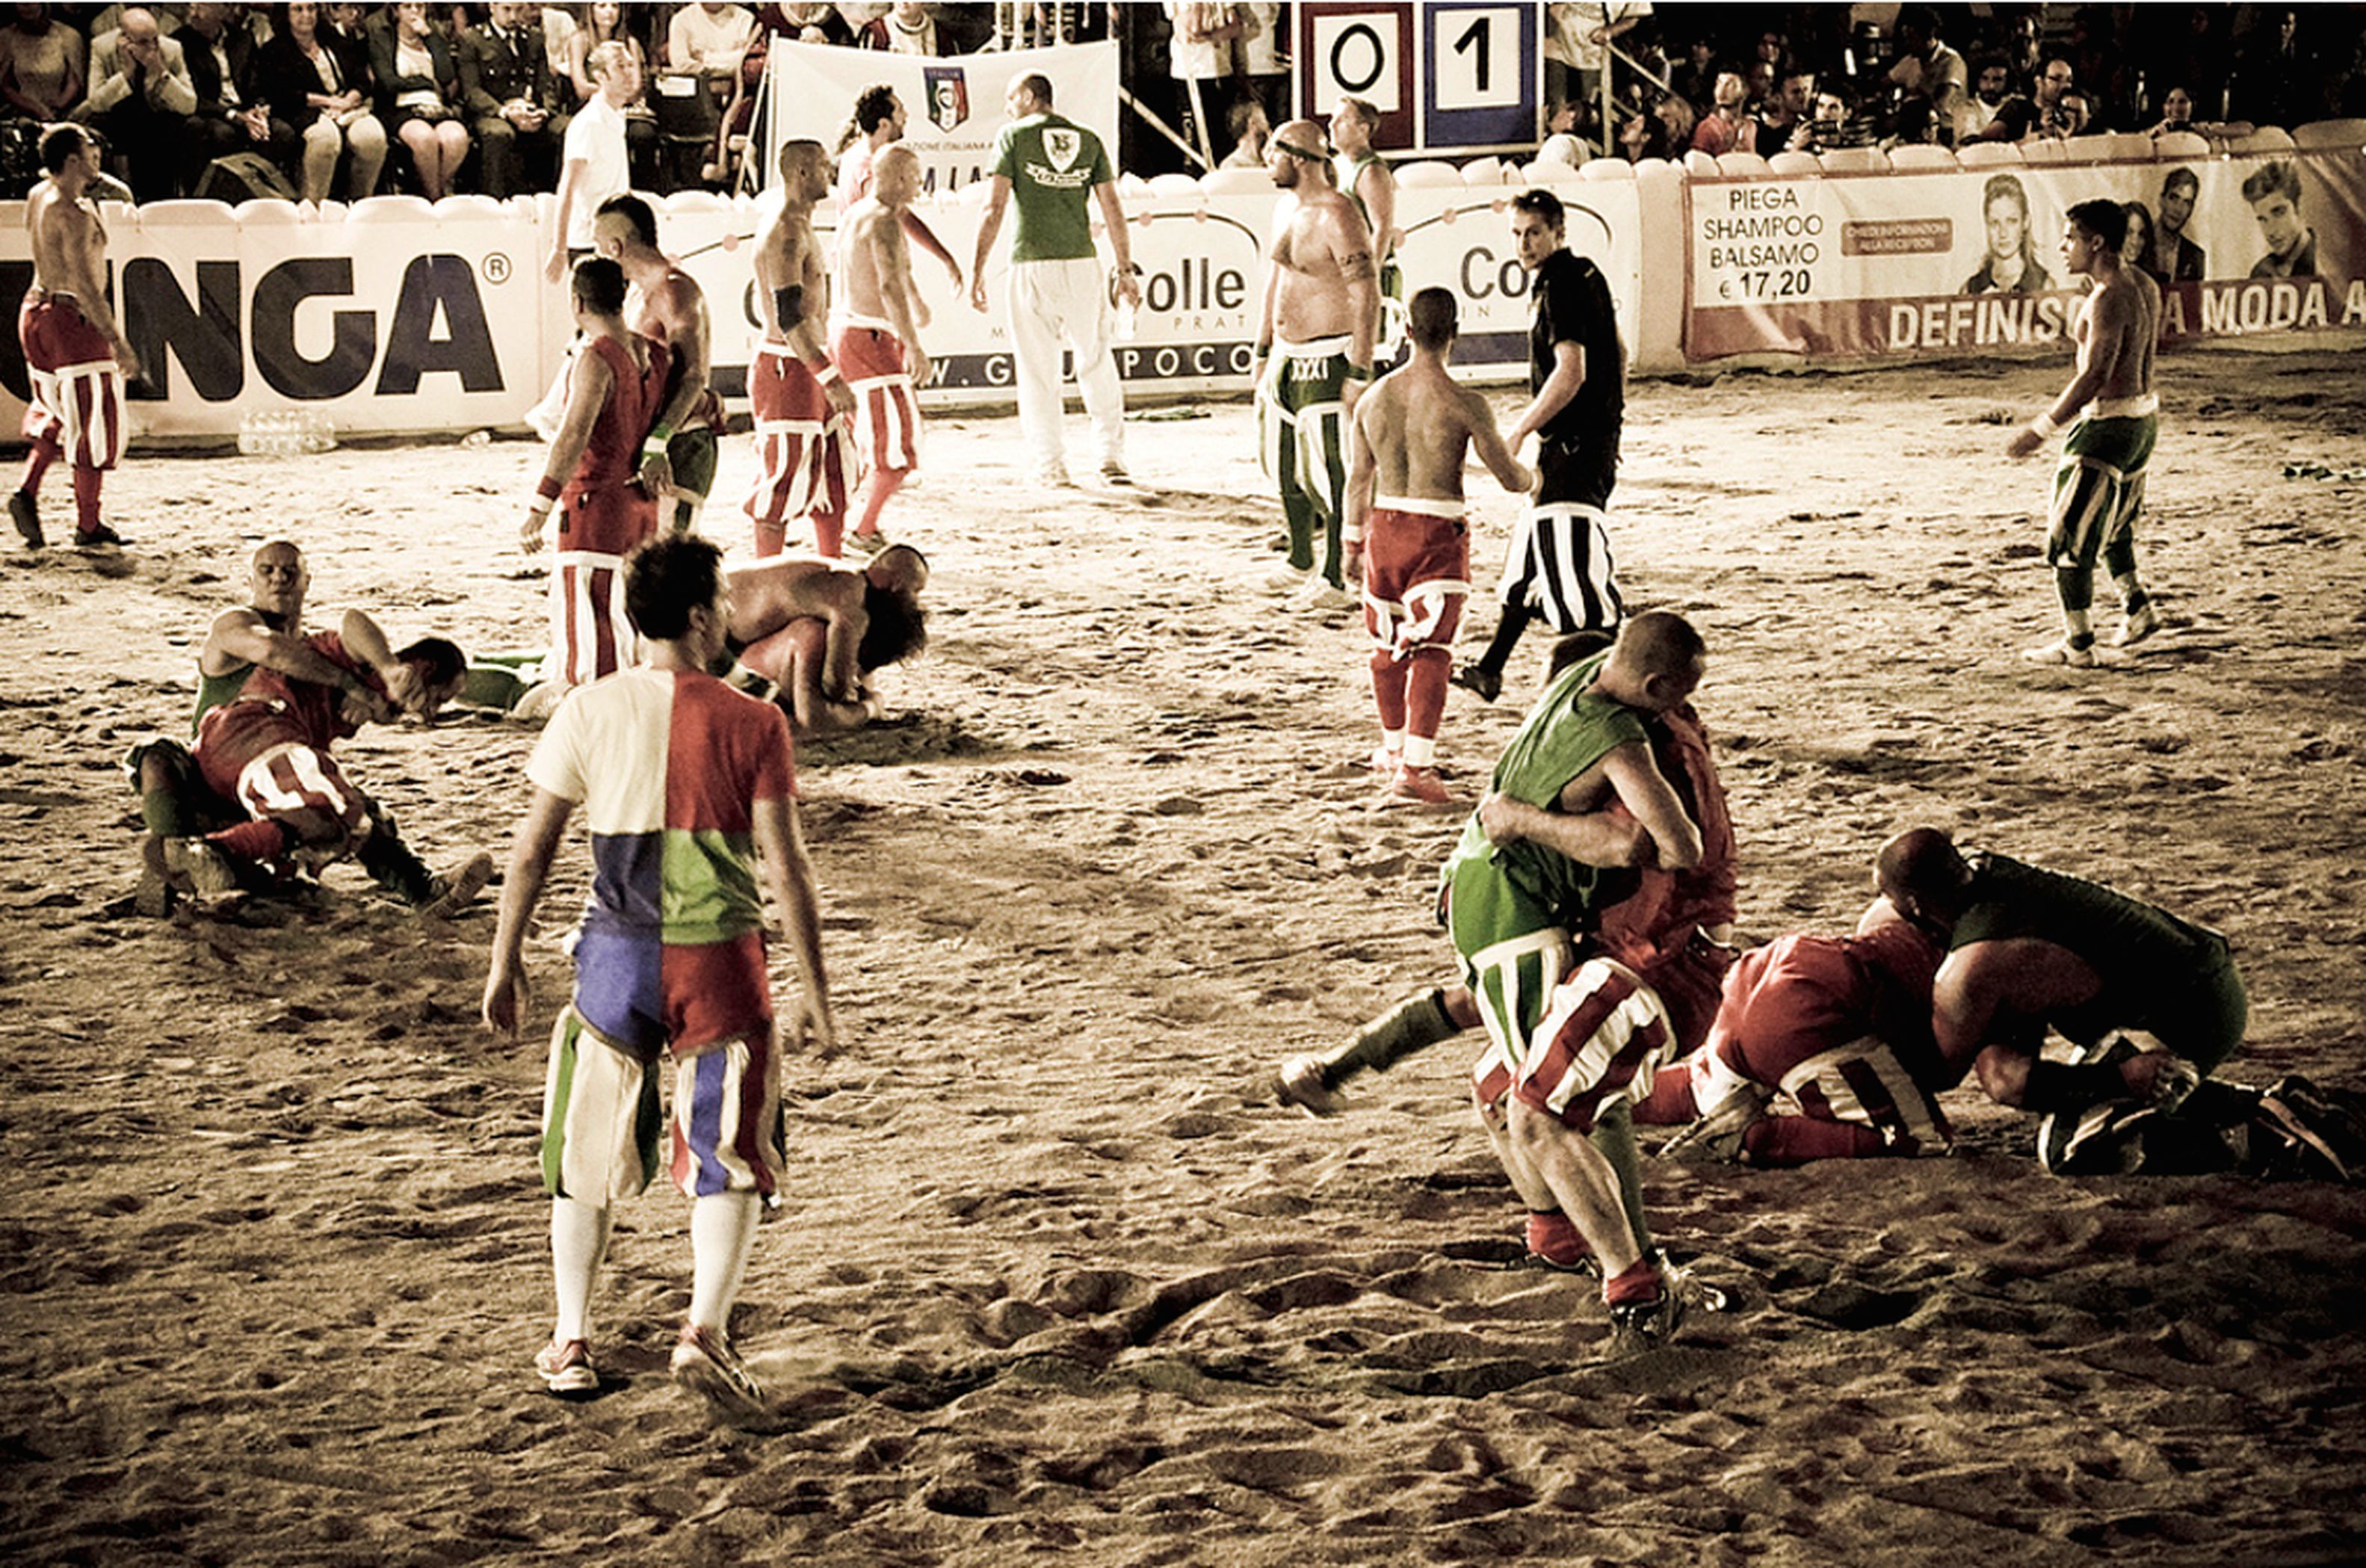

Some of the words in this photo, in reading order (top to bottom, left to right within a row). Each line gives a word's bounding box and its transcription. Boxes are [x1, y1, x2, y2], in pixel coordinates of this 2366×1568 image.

[1329, 22, 1385, 93] 0
[1454, 17, 1489, 91] 1
[1729, 188, 1799, 211] PIEGA
[1704, 214, 1823, 241] SHAMPOO
[1711, 242, 1819, 268] BALSAMO
[1740, 269, 1811, 300] 17,20
[2202, 283, 2328, 334] MODA
